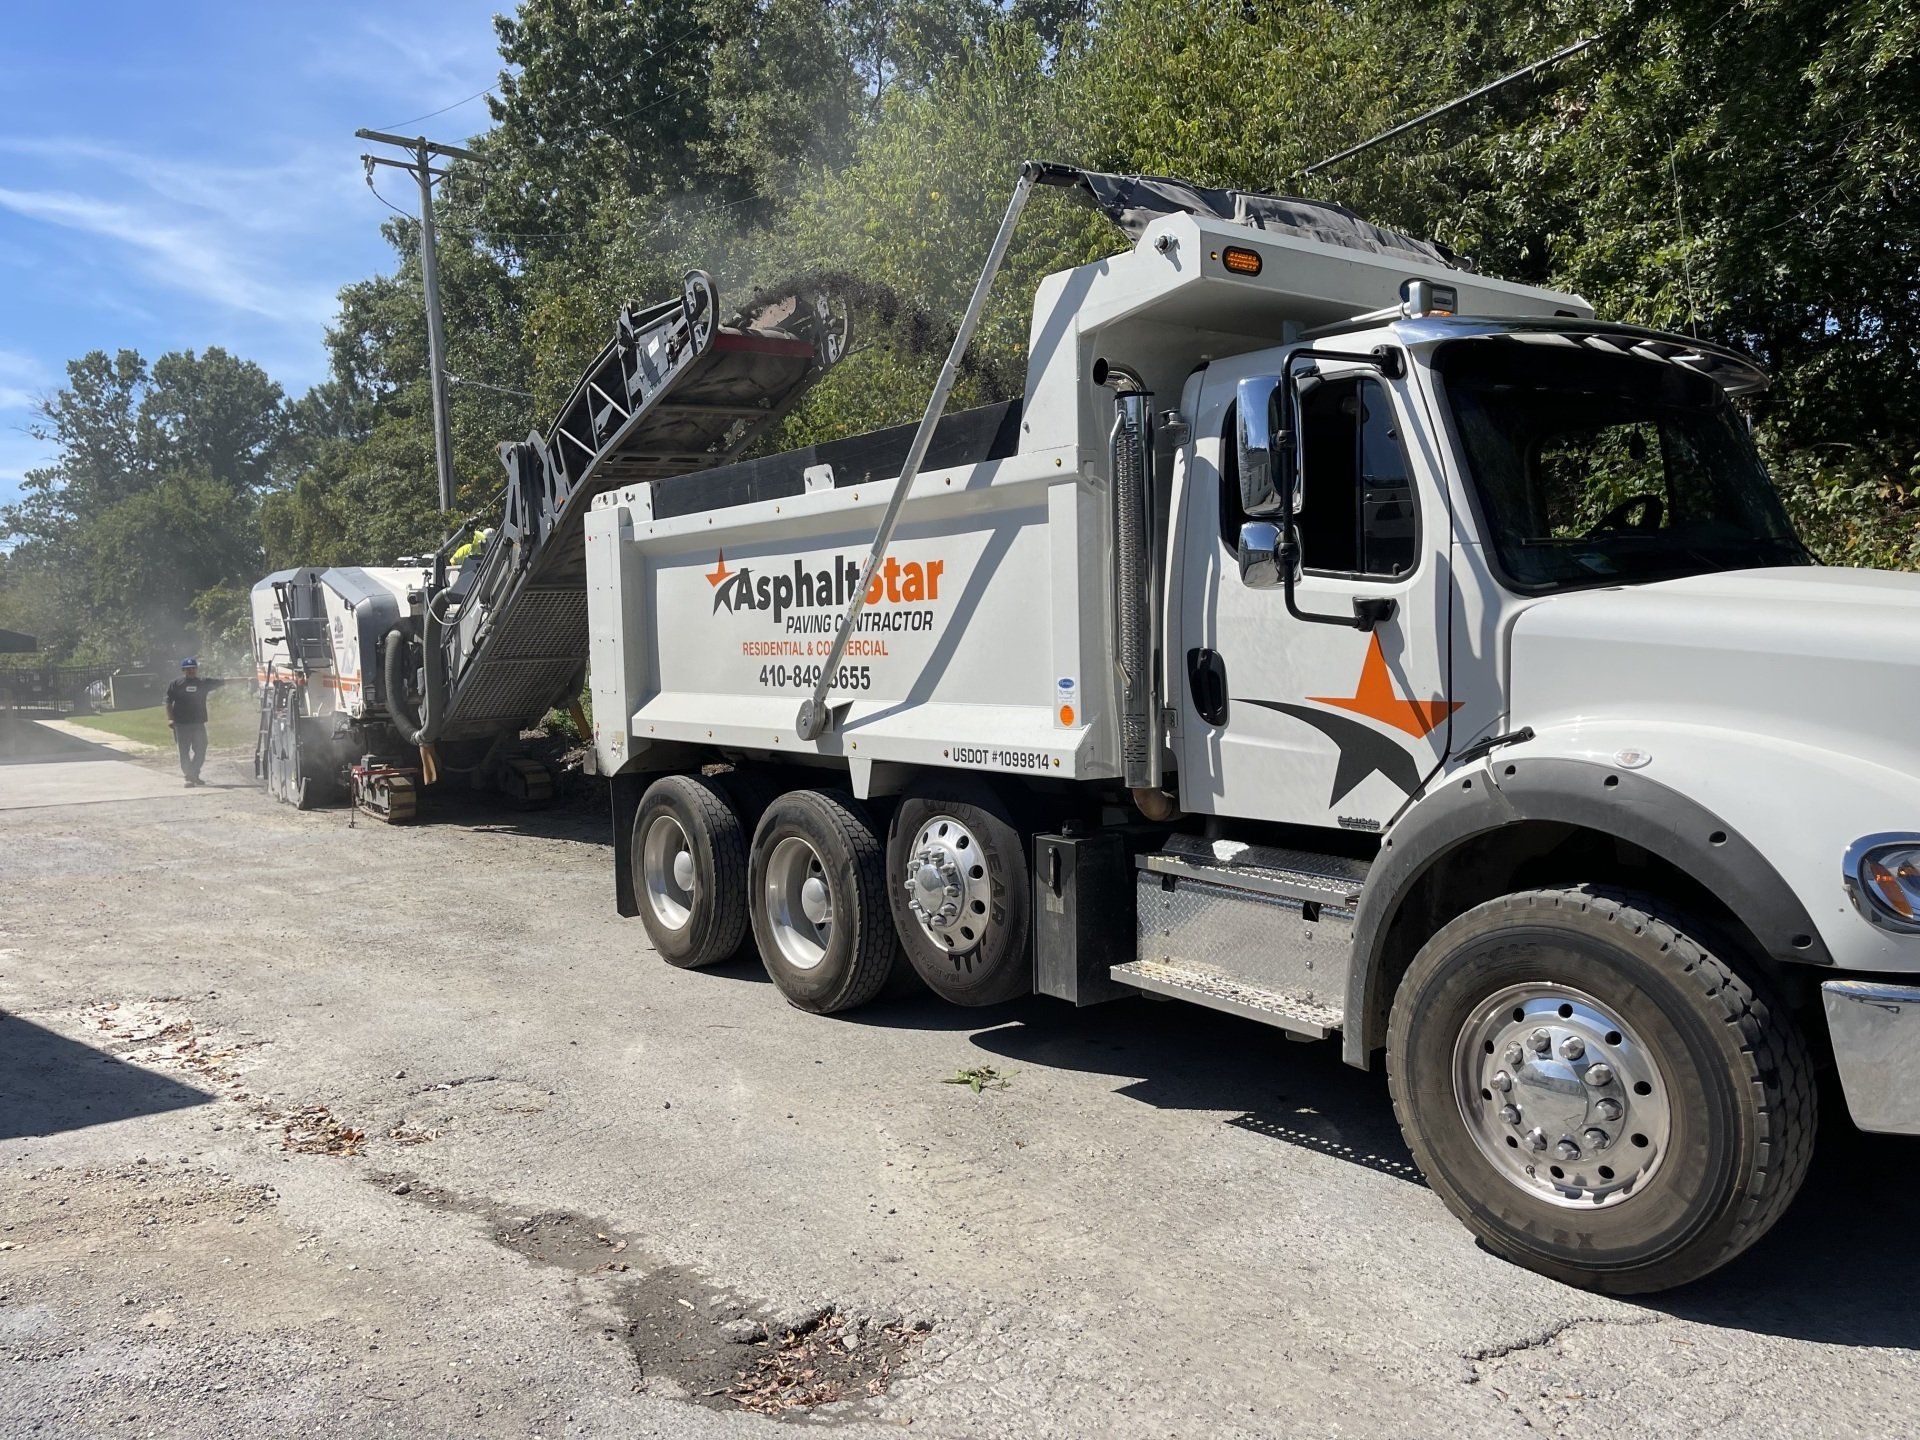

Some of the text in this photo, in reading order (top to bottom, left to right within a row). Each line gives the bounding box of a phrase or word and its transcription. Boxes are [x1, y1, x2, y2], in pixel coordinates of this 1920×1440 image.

[786, 610, 934, 634] PAVING CNTRACTOR
[742, 640, 889, 656] RESIDENTIAL & COERCIAL
[759, 664, 871, 690] 410-849655
[952, 747, 1050, 770] USDOT #1099814
